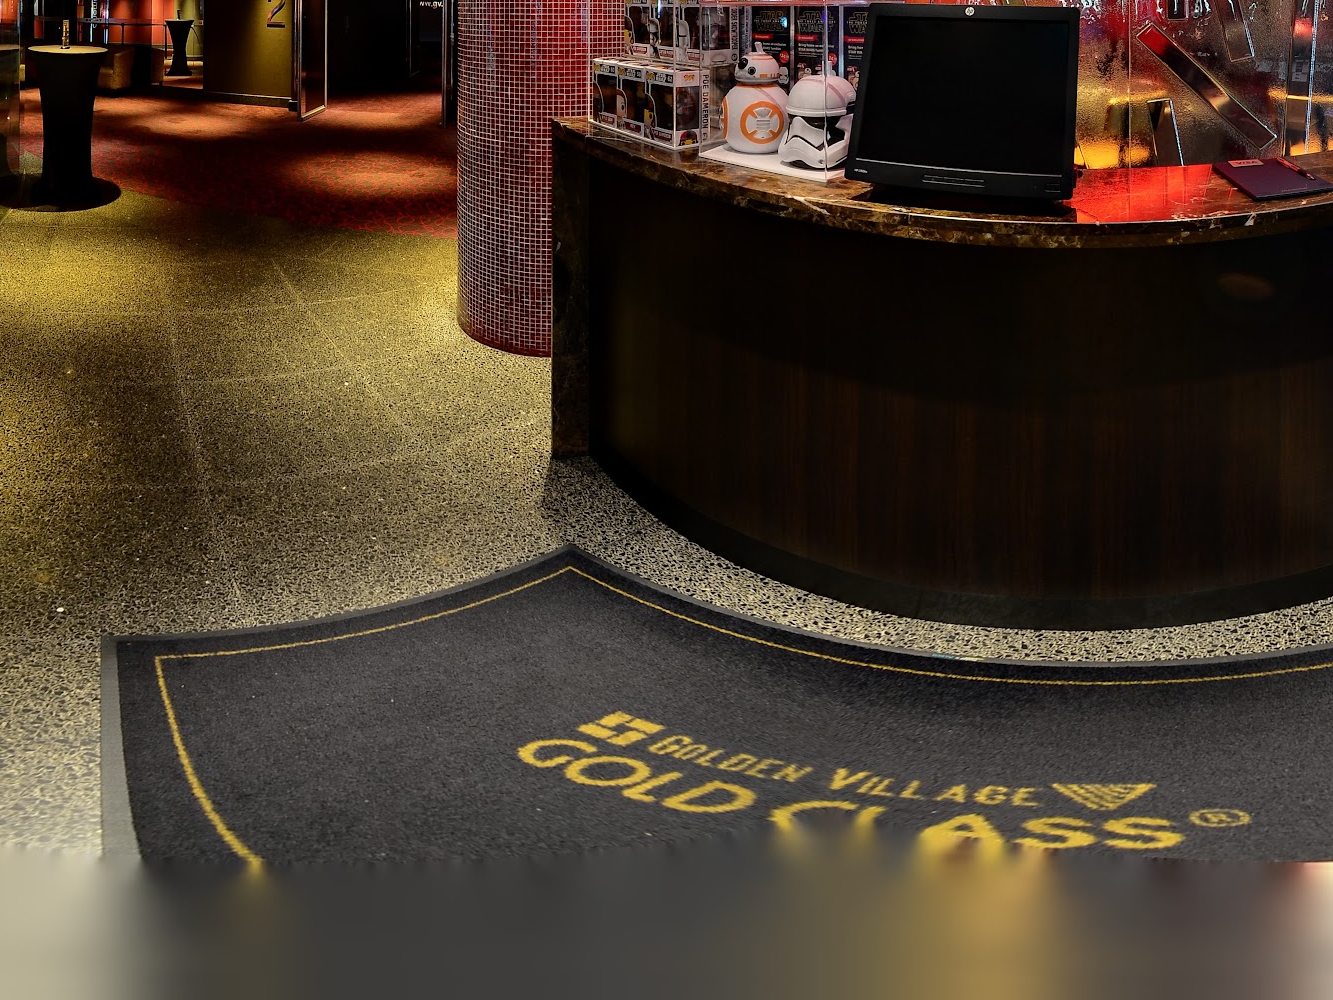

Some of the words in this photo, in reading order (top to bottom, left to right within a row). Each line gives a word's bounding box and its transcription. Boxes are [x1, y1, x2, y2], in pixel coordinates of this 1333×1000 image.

[701, 93, 709, 129] DAMERON
[514, 738, 757, 814] GOLD
[647, 733, 813, 783] GOLDEN
[829, 768, 1058, 808] VILLAGE
